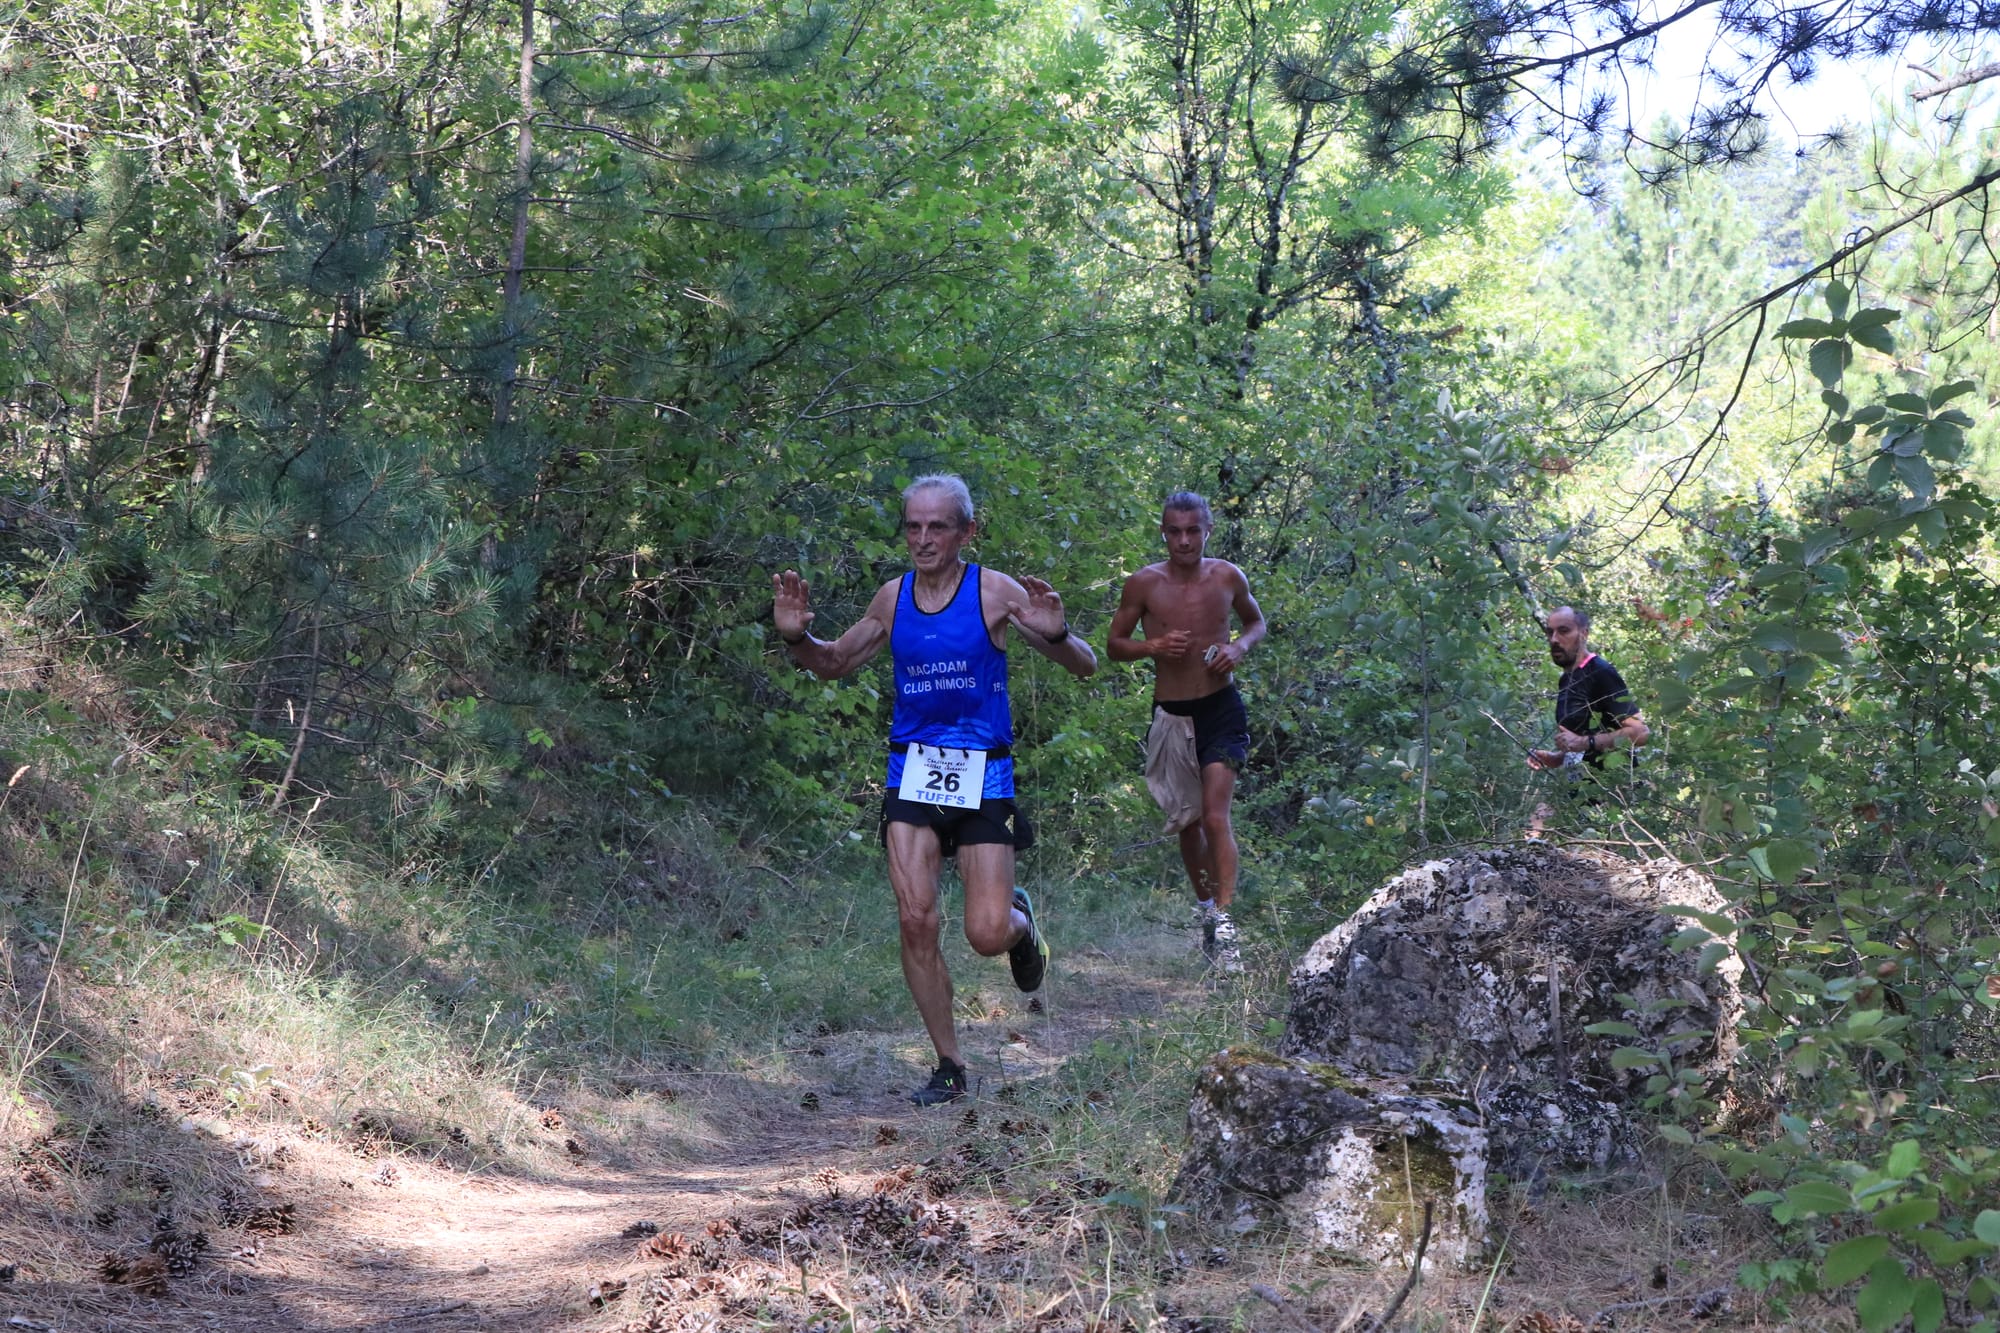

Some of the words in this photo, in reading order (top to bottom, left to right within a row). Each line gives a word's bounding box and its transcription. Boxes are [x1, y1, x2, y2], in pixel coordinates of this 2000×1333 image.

[907, 660, 967, 677] MACADAM
[903, 680, 932, 694] CLUB
[925, 770, 961, 792] 26
[916, 790, 966, 806] TUFF'S
